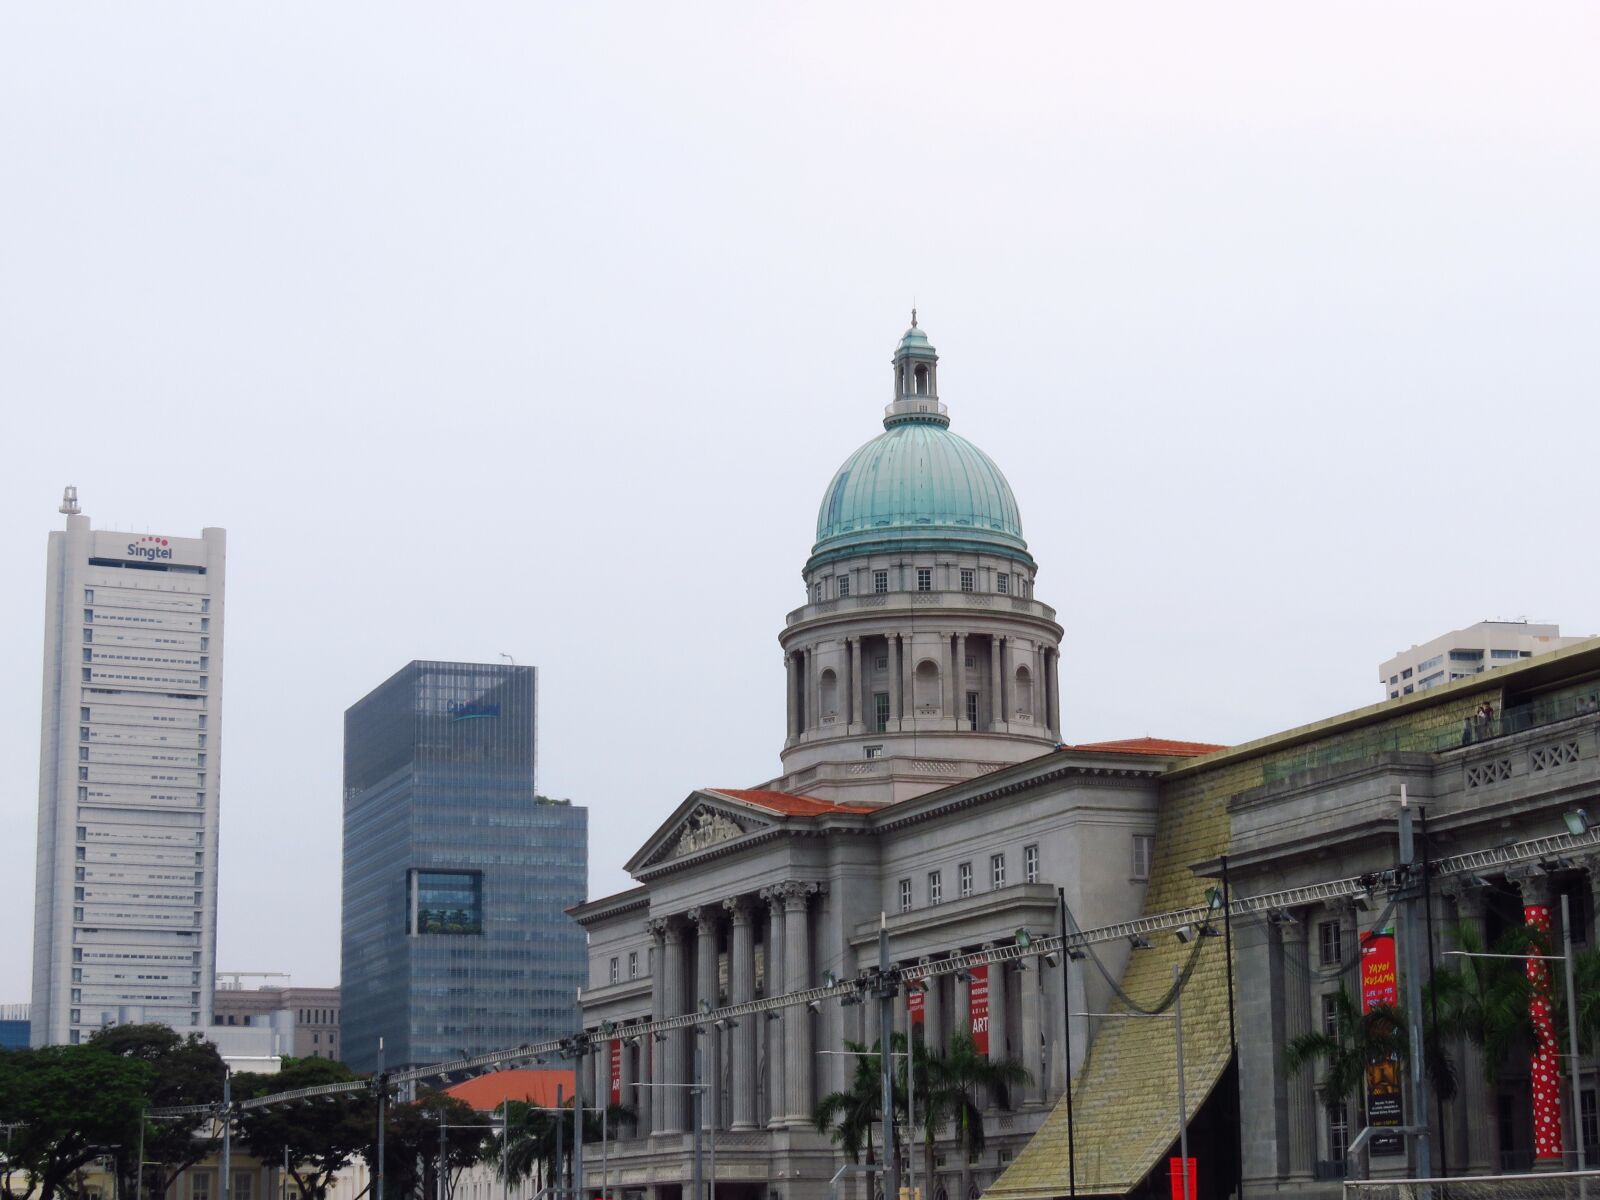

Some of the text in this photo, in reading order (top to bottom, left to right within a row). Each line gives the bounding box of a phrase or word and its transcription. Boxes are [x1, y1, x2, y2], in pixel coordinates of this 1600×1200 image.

[127, 541, 172, 561] Singtel
[1368, 961, 1390, 974] YAYOI
[1364, 973, 1394, 986] KUSAMA
[971, 1017, 988, 1034] ART
